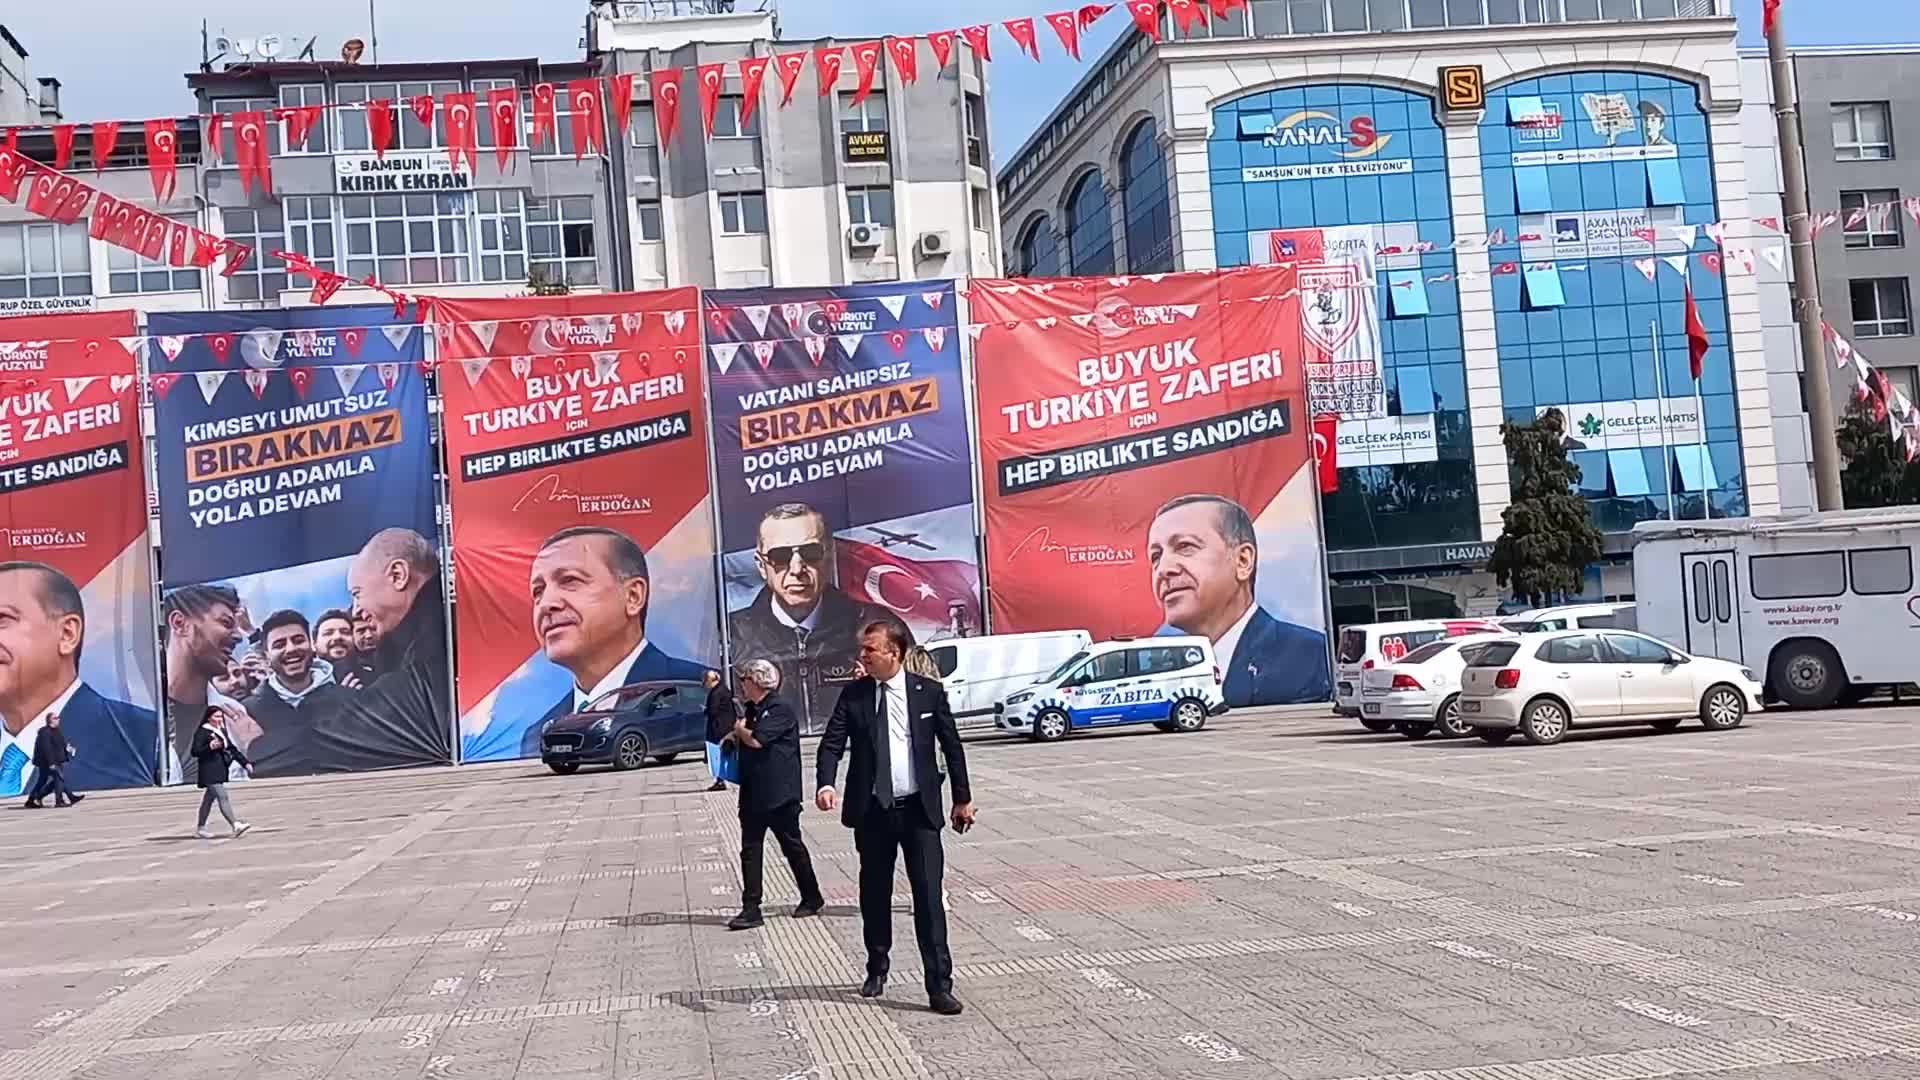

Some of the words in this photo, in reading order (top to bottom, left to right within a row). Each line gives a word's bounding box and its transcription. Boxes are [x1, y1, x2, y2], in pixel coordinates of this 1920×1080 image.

[849, 134, 884, 145] AVUKAT
[1263, 126, 1348, 147] KANAL
[360, 159, 422, 171] SAMSUN
[1315, 166, 1335, 175] TEK
[341, 174, 398, 191] KIRIK
[402, 172, 468, 189] EKRAN
[1587, 218, 1608, 229] AXA
[1611, 215, 1647, 227] HAYAT
[21, 299, 44, 310] ÖZEL
[46, 297, 91, 309] GÜVENLİK
[1078, 337, 1199, 386] BÜYÜK
[463, 395, 583, 435] TÜRKİYE
[592, 373, 684, 412] ZAFERİ
[738, 382, 814, 411] VATANI
[1001, 381, 1150, 433] TÜRKİYE
[1160, 351, 1282, 404] ZAFERİ
[22, 401, 121, 441] ZAFERİ
[184, 413, 276, 443] KİMSEYİ
[280, 389, 388, 424] UMUTSUZ
[748, 384, 932, 444] BIRAKMAZ
[1607, 416, 1657, 427] GELECEK
[195, 415, 395, 477] BIRAKMAZ
[466, 455, 505, 476] HEP
[509, 437, 596, 469] BİRLİKTE
[600, 417, 686, 450] SANDIĞA
[743, 443, 818, 473] DOĞRU
[822, 423, 913, 456] ADAMLA
[1005, 458, 1056, 487] HEP
[1060, 436, 1168, 476] BİRLİKTE
[1173, 408, 1284, 453] SANDIĞA
[1337, 433, 1387, 445] GELECEK
[31, 448, 122, 481] SANDIĞA
[745, 470, 804, 494] YOLA
[807, 450, 883, 481] DEVAM
[188, 474, 271, 507] DOĞRU
[276, 455, 375, 488] ADAMLA
[190, 505, 254, 528] YOLA
[259, 484, 342, 515] DEVAM
[581, 498, 651, 513] ERDOĞAN
[12, 531, 86, 546] ERDOĞAN
[1070, 548, 1133, 562] ERDOĞAN
[1101, 688, 1163, 705] ZABITA
